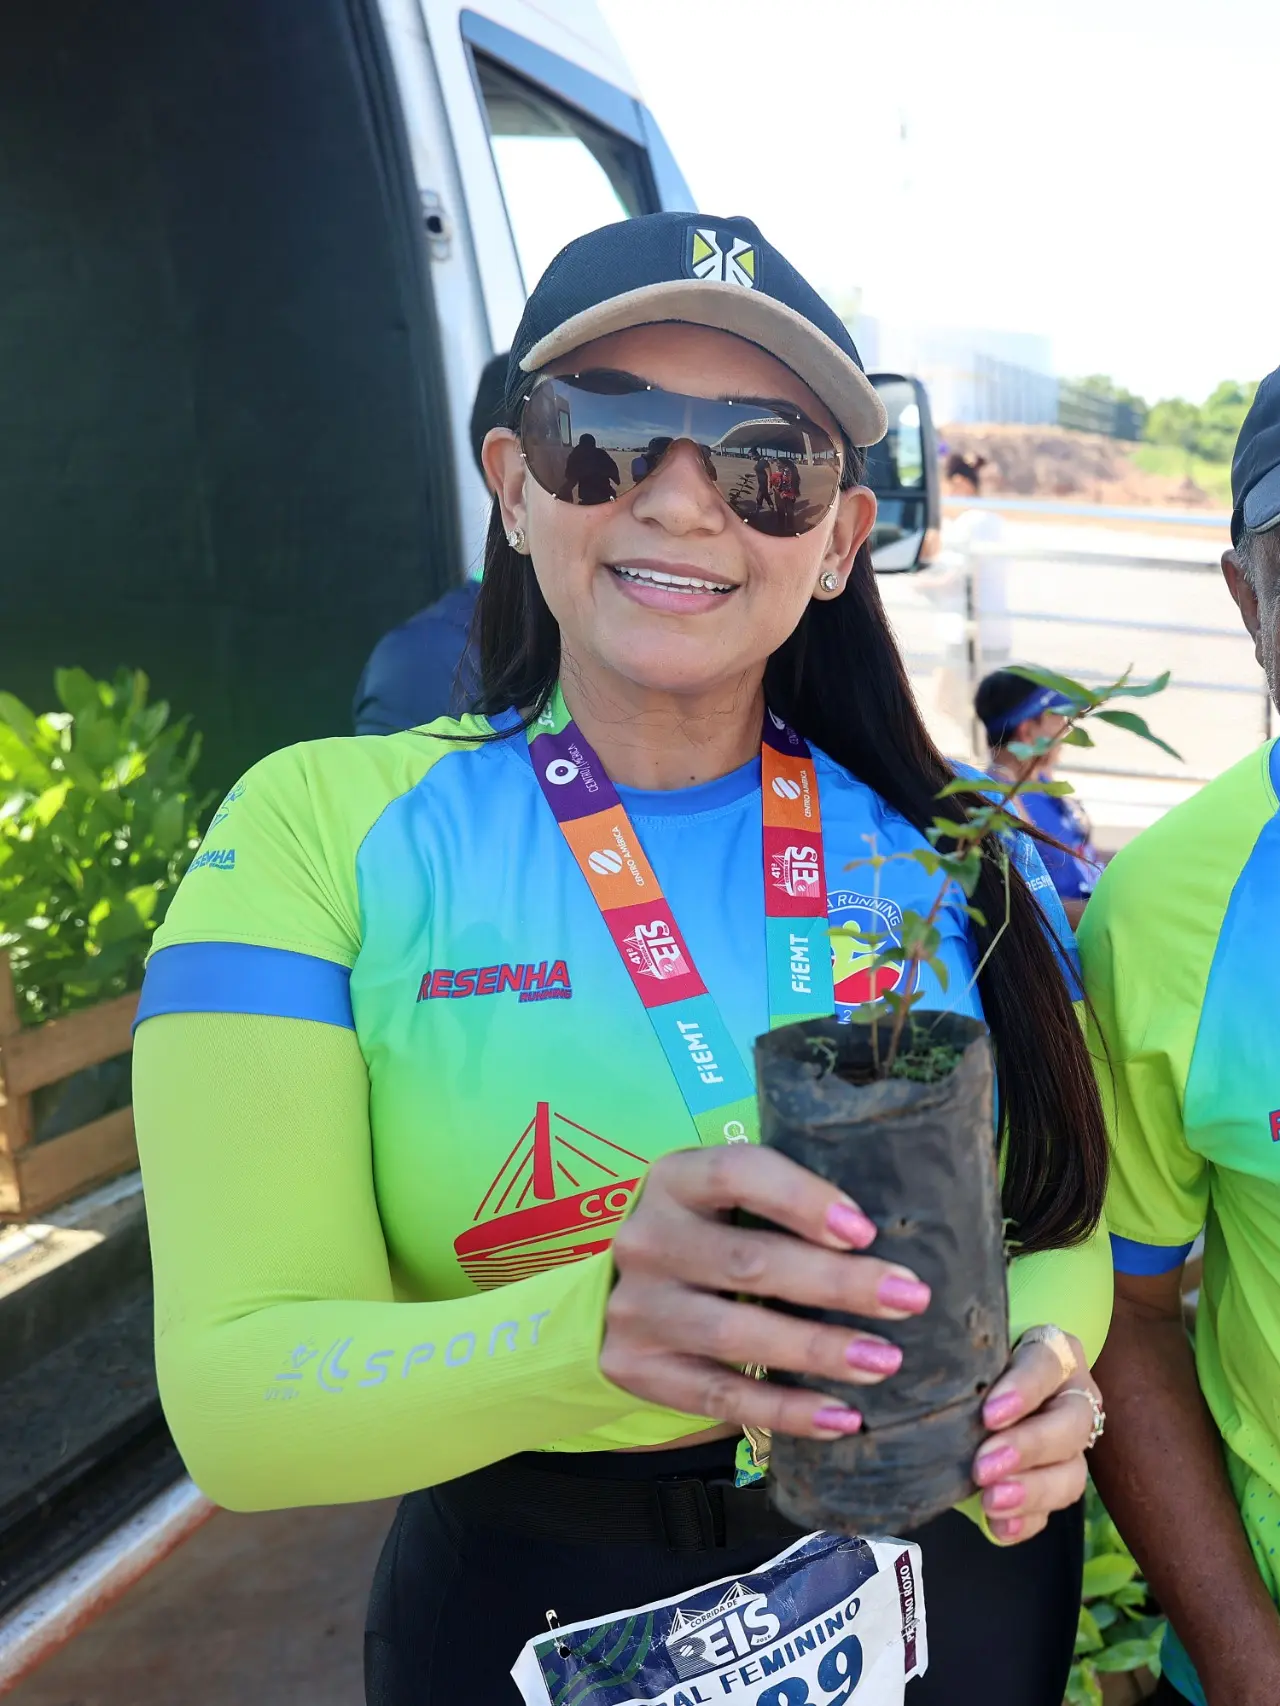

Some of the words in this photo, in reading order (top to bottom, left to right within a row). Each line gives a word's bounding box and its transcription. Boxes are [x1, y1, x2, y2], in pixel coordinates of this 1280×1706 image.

[803, 793, 812, 818] CENTRO
[627, 860, 645, 887] CENTRO
[838, 894, 900, 927] RUNNING
[416, 960, 572, 1003] RESENHA
[358, 1308, 551, 1388] SPORT
[900, 1565, 914, 1598] ROXO
[690, 1605, 726, 1628] CORRIDA
[727, 1600, 738, 1609] DE
[719, 1597, 861, 1694] FEMININO
